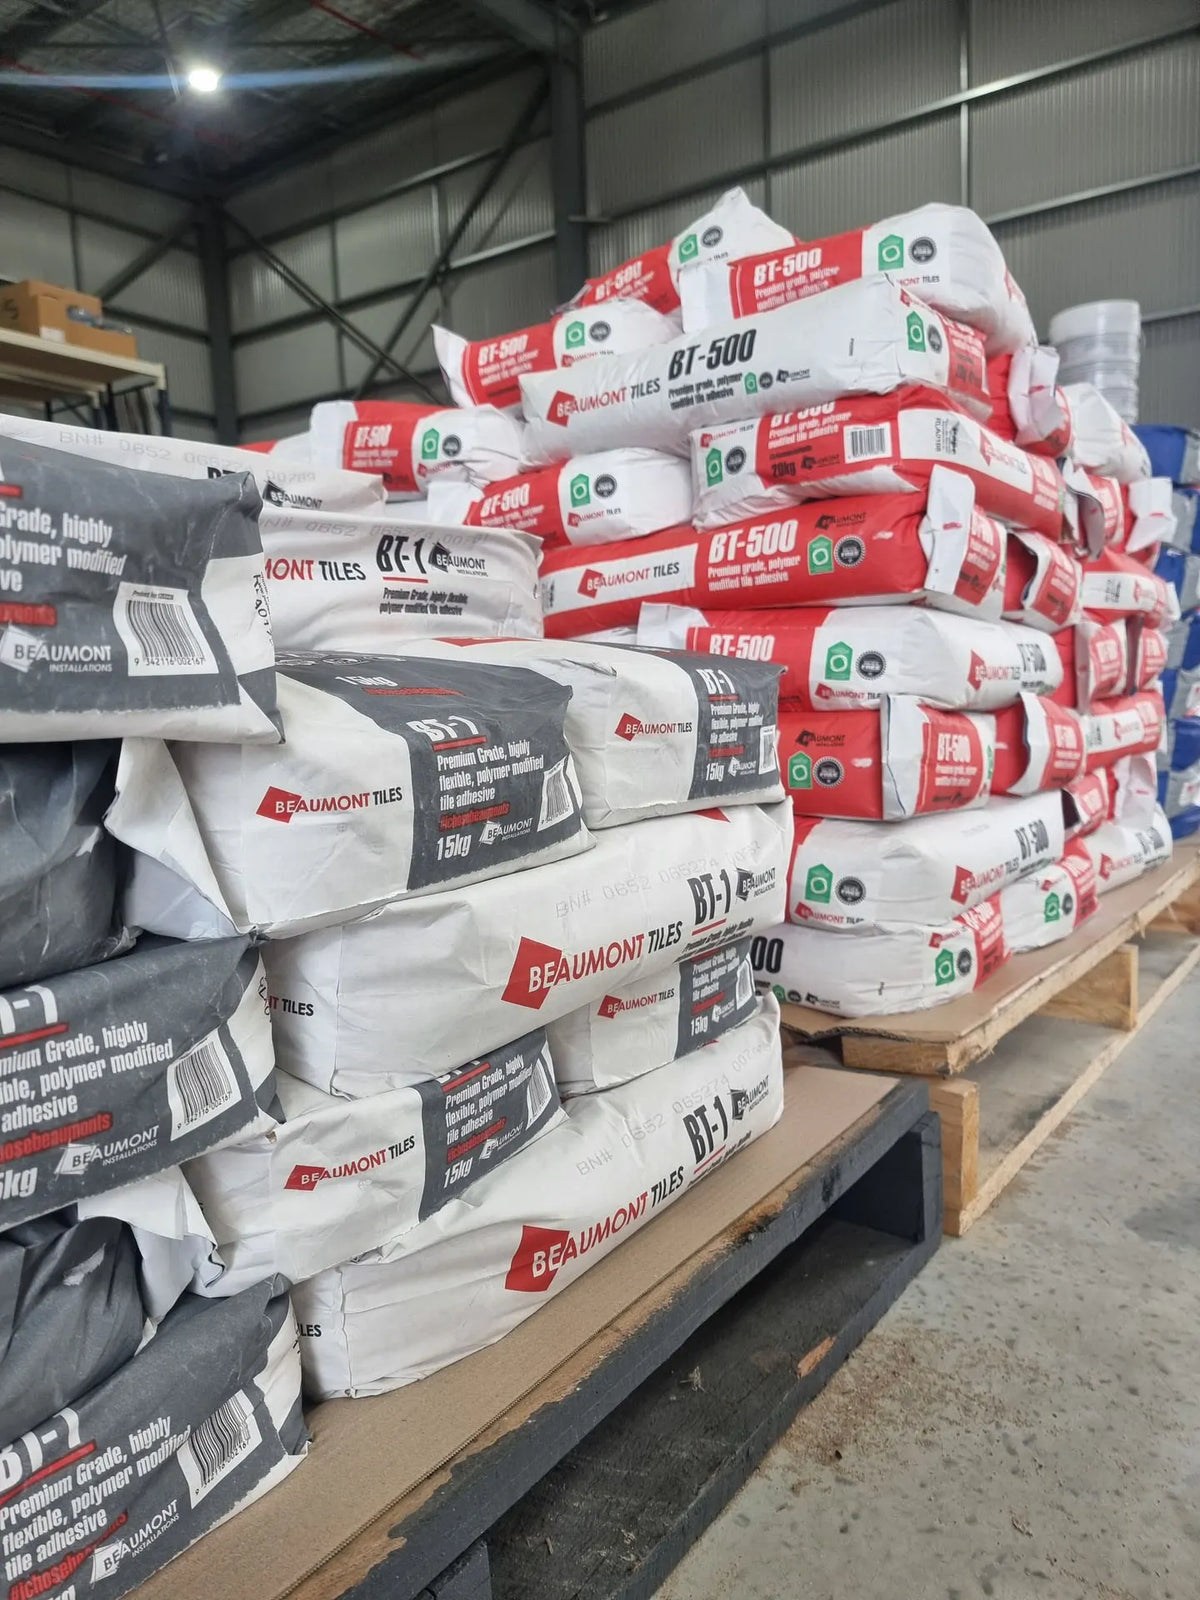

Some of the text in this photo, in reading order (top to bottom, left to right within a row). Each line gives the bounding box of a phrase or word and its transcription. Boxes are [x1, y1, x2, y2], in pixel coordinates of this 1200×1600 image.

[754, 247, 822, 287] BT-500
[478, 334, 529, 366] BT-500
[668, 329, 757, 381] BT-500
[556, 378, 661, 418] BEAUMONT TILES
[771, 460, 796, 478] 20kg
[270, 489, 322, 509] BEAUMONT
[480, 483, 530, 517] BT-500
[63, 512, 113, 548] highly
[708, 519, 799, 564] BT-500
[0, 534, 127, 576] olymer modified
[319, 560, 366, 581] TILES
[376, 534, 427, 574] BT-1
[436, 553, 486, 570] BEAUMONT
[586, 562, 680, 591] BEAUMONT TILES
[14, 644, 112, 662] BEAUMONT
[133, 657, 140, 666] 9
[710, 633, 775, 662] BT-500
[49, 663, 113, 673] INSTALLATIONS
[696, 668, 736, 695] BT-1
[406, 715, 479, 742] BT-1
[625, 722, 693, 735] BEAUMONT TILES
[437, 740, 531, 772] Premium Grade, highly
[706, 762, 725, 782] 15kg
[439, 755, 544, 792] flexible, polymer modified
[275, 786, 403, 815] BEAUMONT TILES
[440, 787, 496, 811] tile adhesive
[488, 817, 534, 840] BEAUMONT
[437, 832, 472, 861] 15kg
[687, 868, 731, 926] BT-1
[742, 867, 776, 893] BEAUMONT
[528, 933, 645, 993] BEAUMONT
[648, 920, 682, 954] TILES
[281, 998, 314, 1017] TILES
[607, 988, 675, 1014] BEAUMONT TILES
[0, 1020, 149, 1078] mium Grade, highly
[0, 1037, 174, 1105] ible, polymer modified
[445, 1080, 481, 1110] Premium
[481, 1067, 505, 1091] Grade,
[505, 1054, 524, 1076] highly
[445, 1102, 477, 1128] flexible,
[478, 1083, 508, 1113] polymer
[736, 1075, 770, 1116] BEAUMONT
[1, 1094, 78, 1133] adhesive
[447, 1109, 493, 1145] tile adhesive
[683, 1095, 729, 1164] BT-1
[72, 1125, 160, 1168] BEAUMONT
[102, 1138, 158, 1167] INSTALLATIONS
[300, 1135, 415, 1185] BEAUMONT TILES
[576, 1148, 613, 1176] BN#
[443, 1157, 473, 1189] 15kg
[532, 1166, 684, 1278] BEAUMONT TILES
[300, 1324, 322, 1338] LES
[0, 1416, 171, 1531] Premium Grade, highly
[2, 1509, 69, 1557] flexible,
[71, 1464, 133, 1514] polymer
[137, 1425, 191, 1476] modified
[4, 1508, 108, 1582] tile adhesive
[103, 1500, 178, 1572] BEAUMONT
[131, 1513, 181, 1559] INSTALLATIONS
